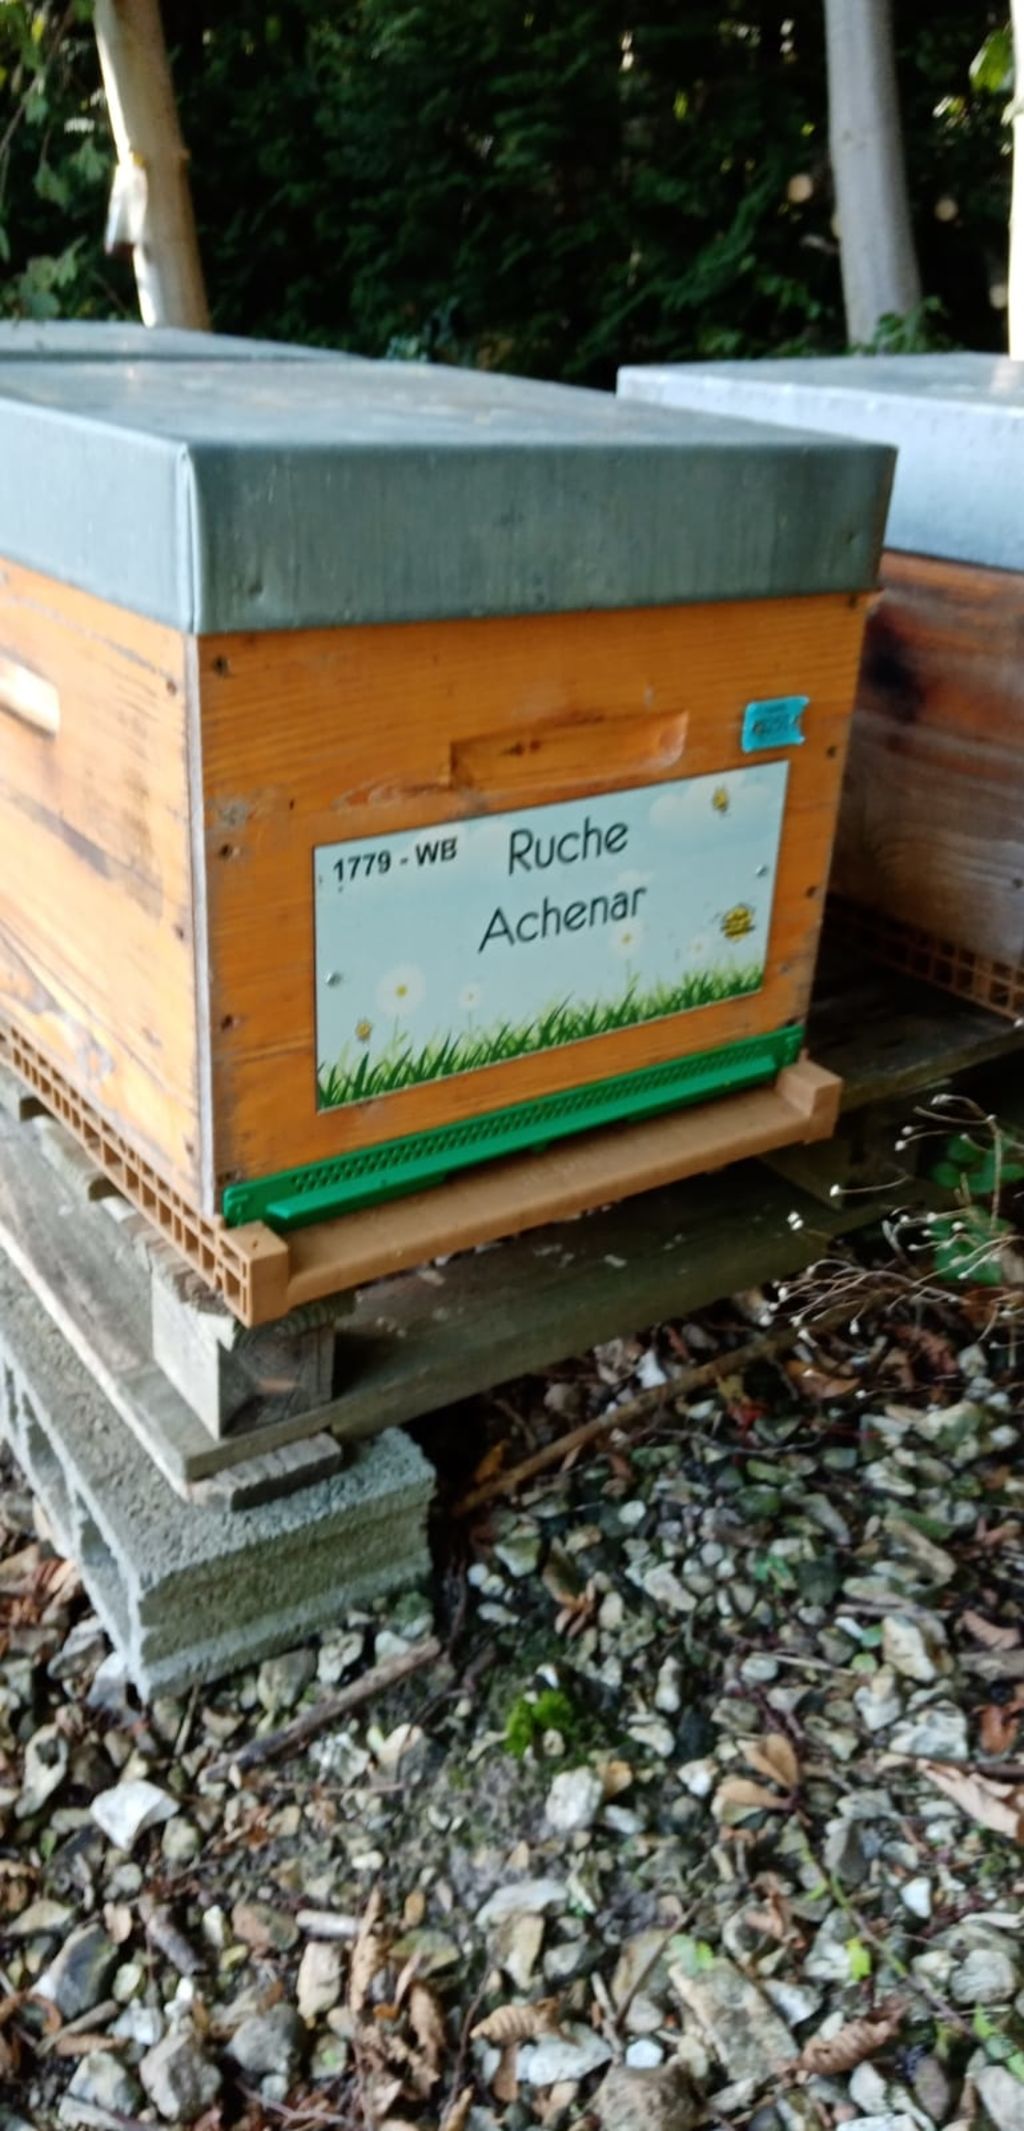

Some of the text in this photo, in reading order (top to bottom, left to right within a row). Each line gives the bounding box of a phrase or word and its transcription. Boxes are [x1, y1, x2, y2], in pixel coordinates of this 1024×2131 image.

[333, 850, 391, 882] 1779
[415, 837, 458, 866] WB
[508, 816, 628, 874] Ruche
[478, 887, 646, 953] Achenar
